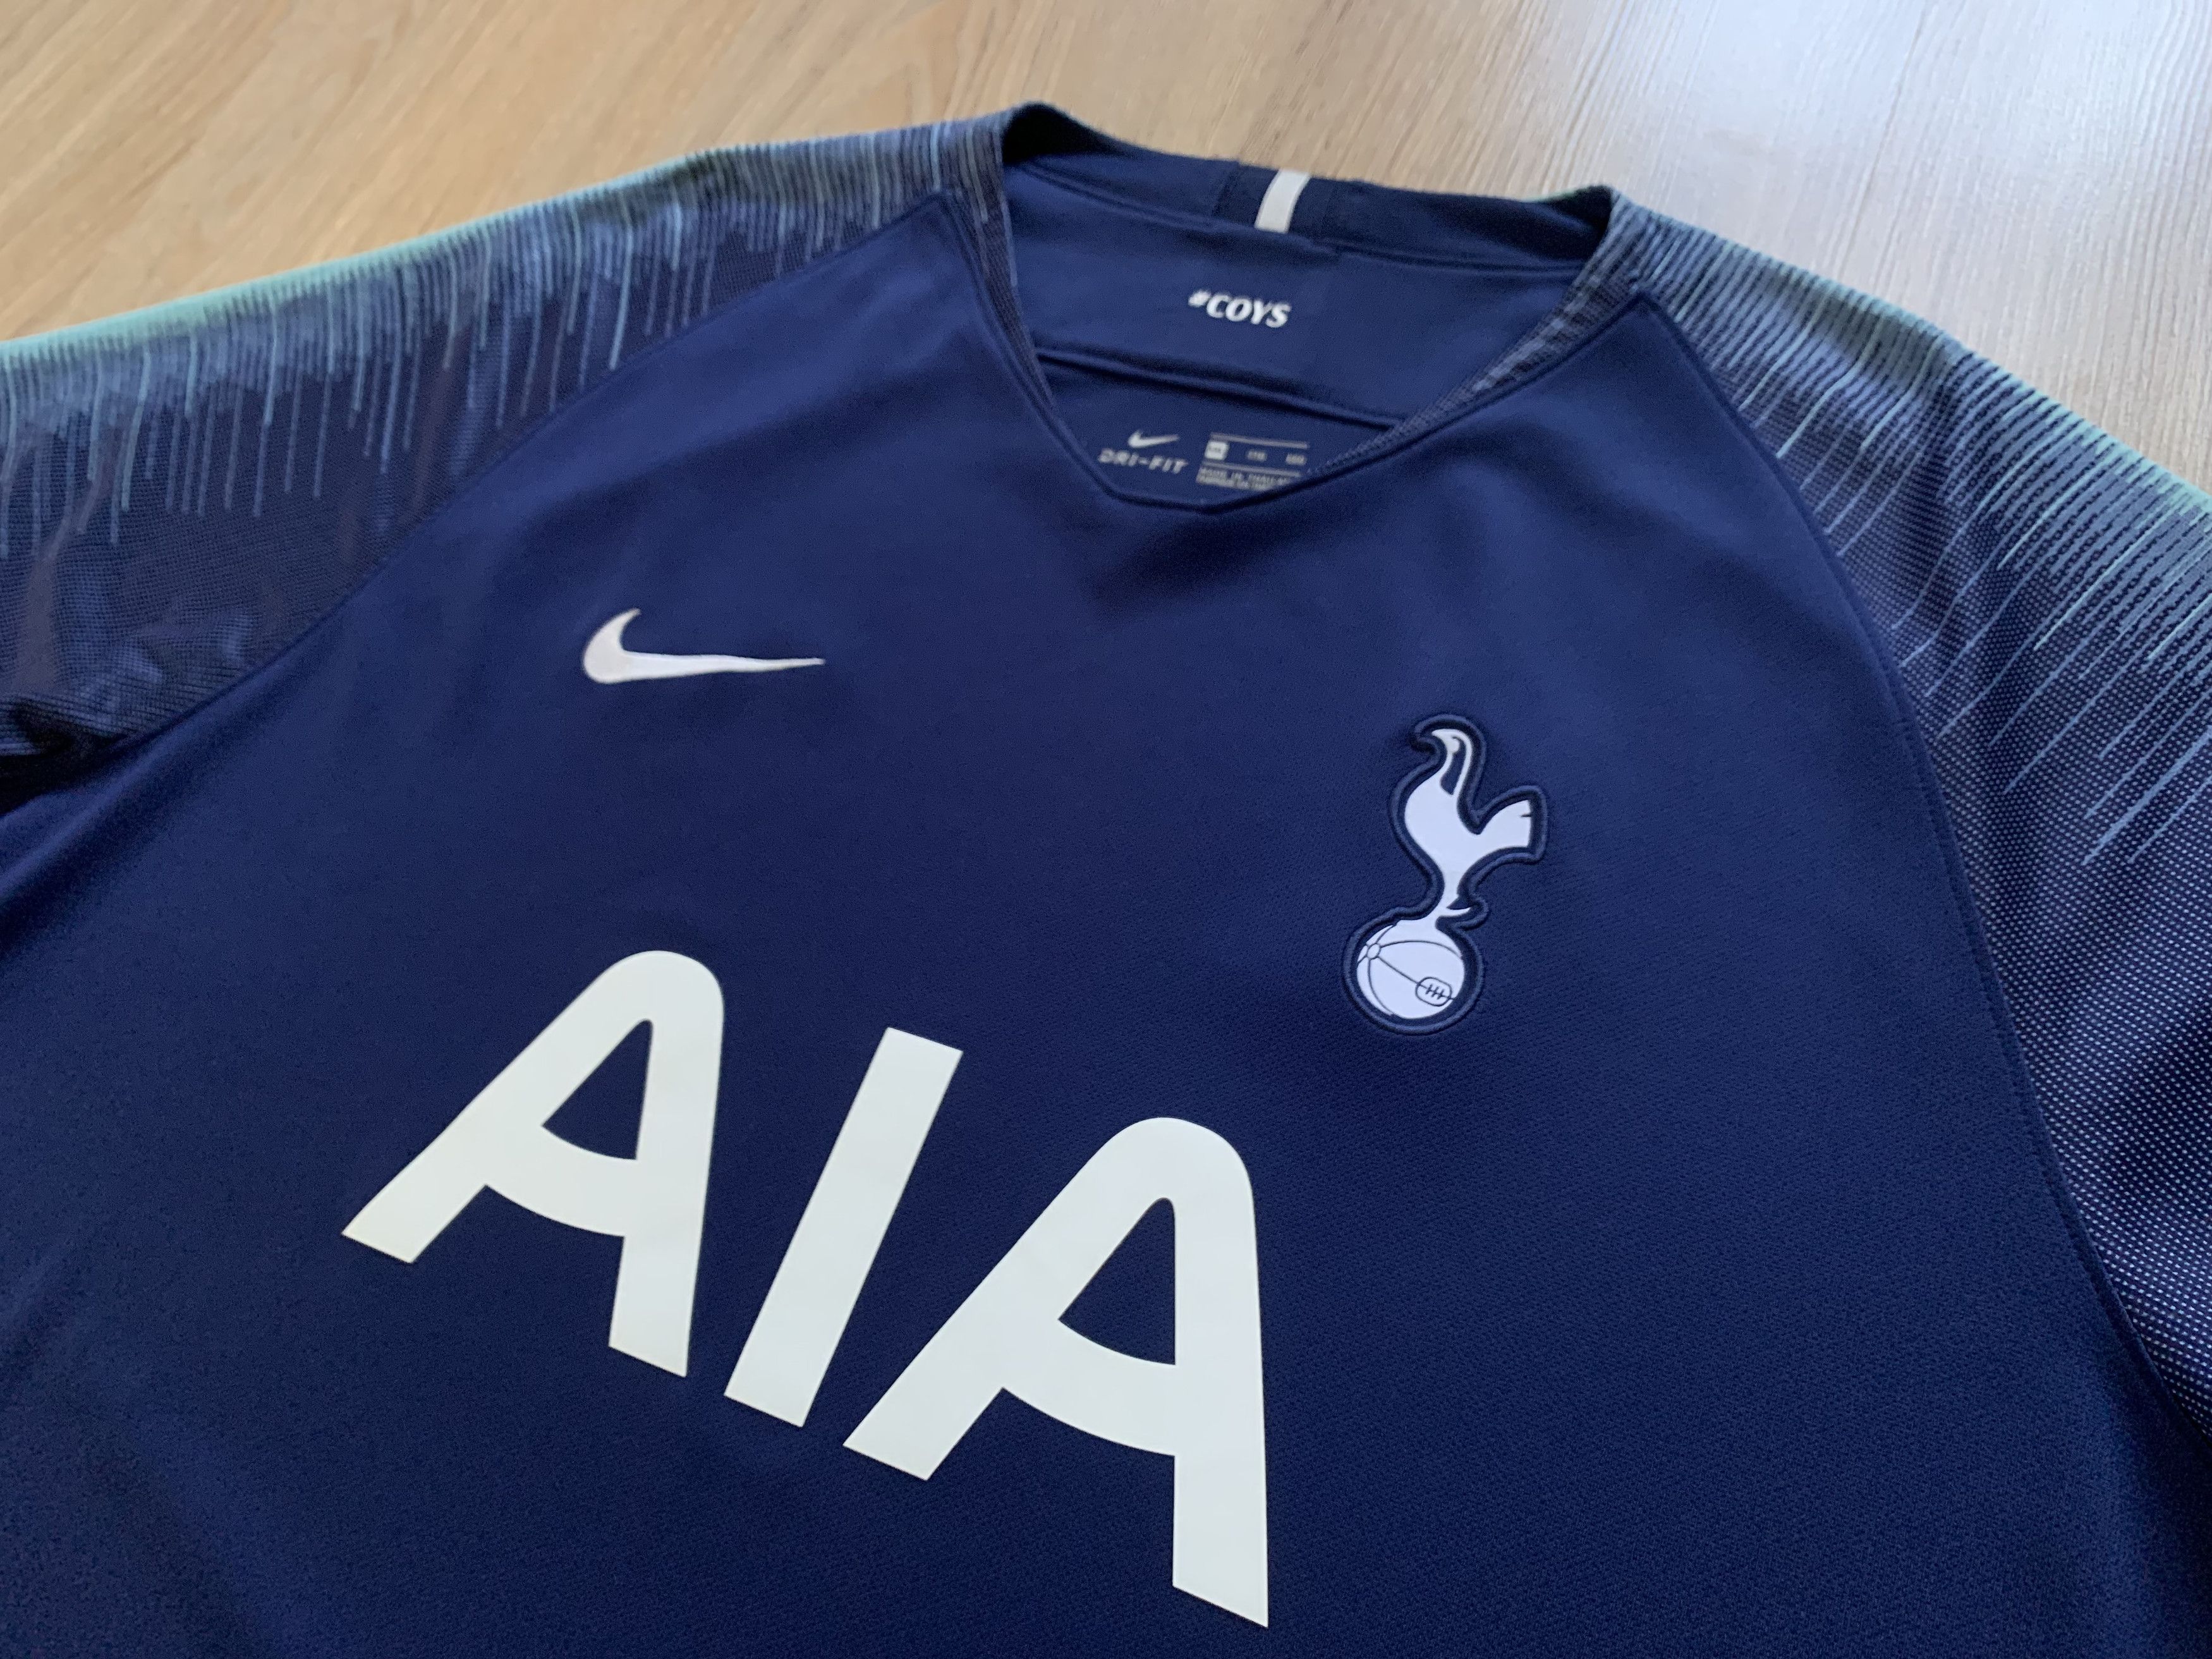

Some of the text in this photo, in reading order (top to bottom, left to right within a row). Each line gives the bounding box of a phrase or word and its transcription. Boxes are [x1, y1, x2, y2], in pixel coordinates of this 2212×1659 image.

[1188, 289, 1291, 329] #COYS
[1098, 448, 1189, 474] DRI-FIT
[342, 951, 1268, 1627] AIA
